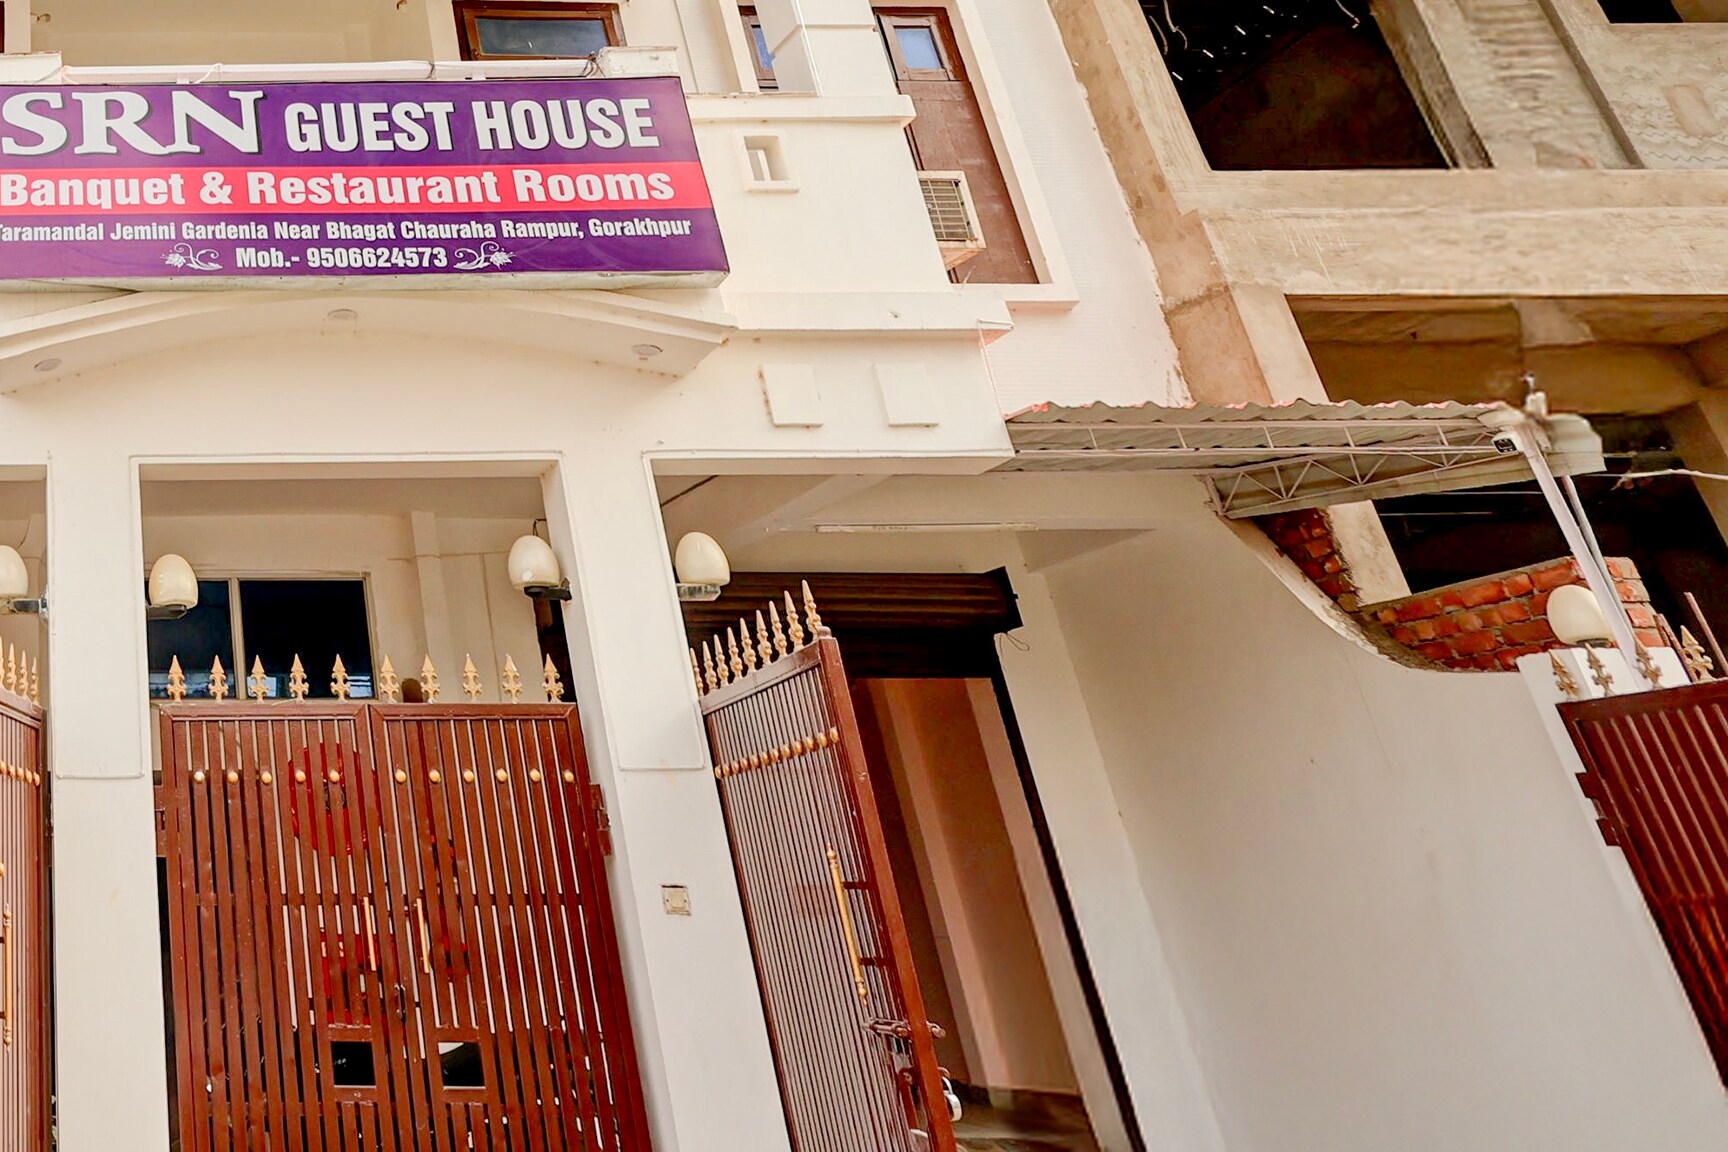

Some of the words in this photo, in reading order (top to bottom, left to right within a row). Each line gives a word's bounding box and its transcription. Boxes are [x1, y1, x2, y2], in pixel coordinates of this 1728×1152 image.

[1, 90, 267, 155] SRN
[284, 101, 454, 152] GUEST
[471, 98, 661, 150] HOUSE
[0, 172, 185, 209] Banquet
[199, 171, 233, 204] &
[247, 170, 502, 205] Restaurant
[512, 168, 675, 203] Rooms
[110, 222, 176, 241] Jemini
[182, 221, 268, 241] Gardenia
[273, 221, 320, 240] Near
[326, 220, 396, 241] Bhagat
[400, 219, 497, 240] Chauraha
[500, 219, 584, 240] Rampur,
[588, 217, 692, 239] Gorakhpur
[307, 247, 448, 269] 9506624573
